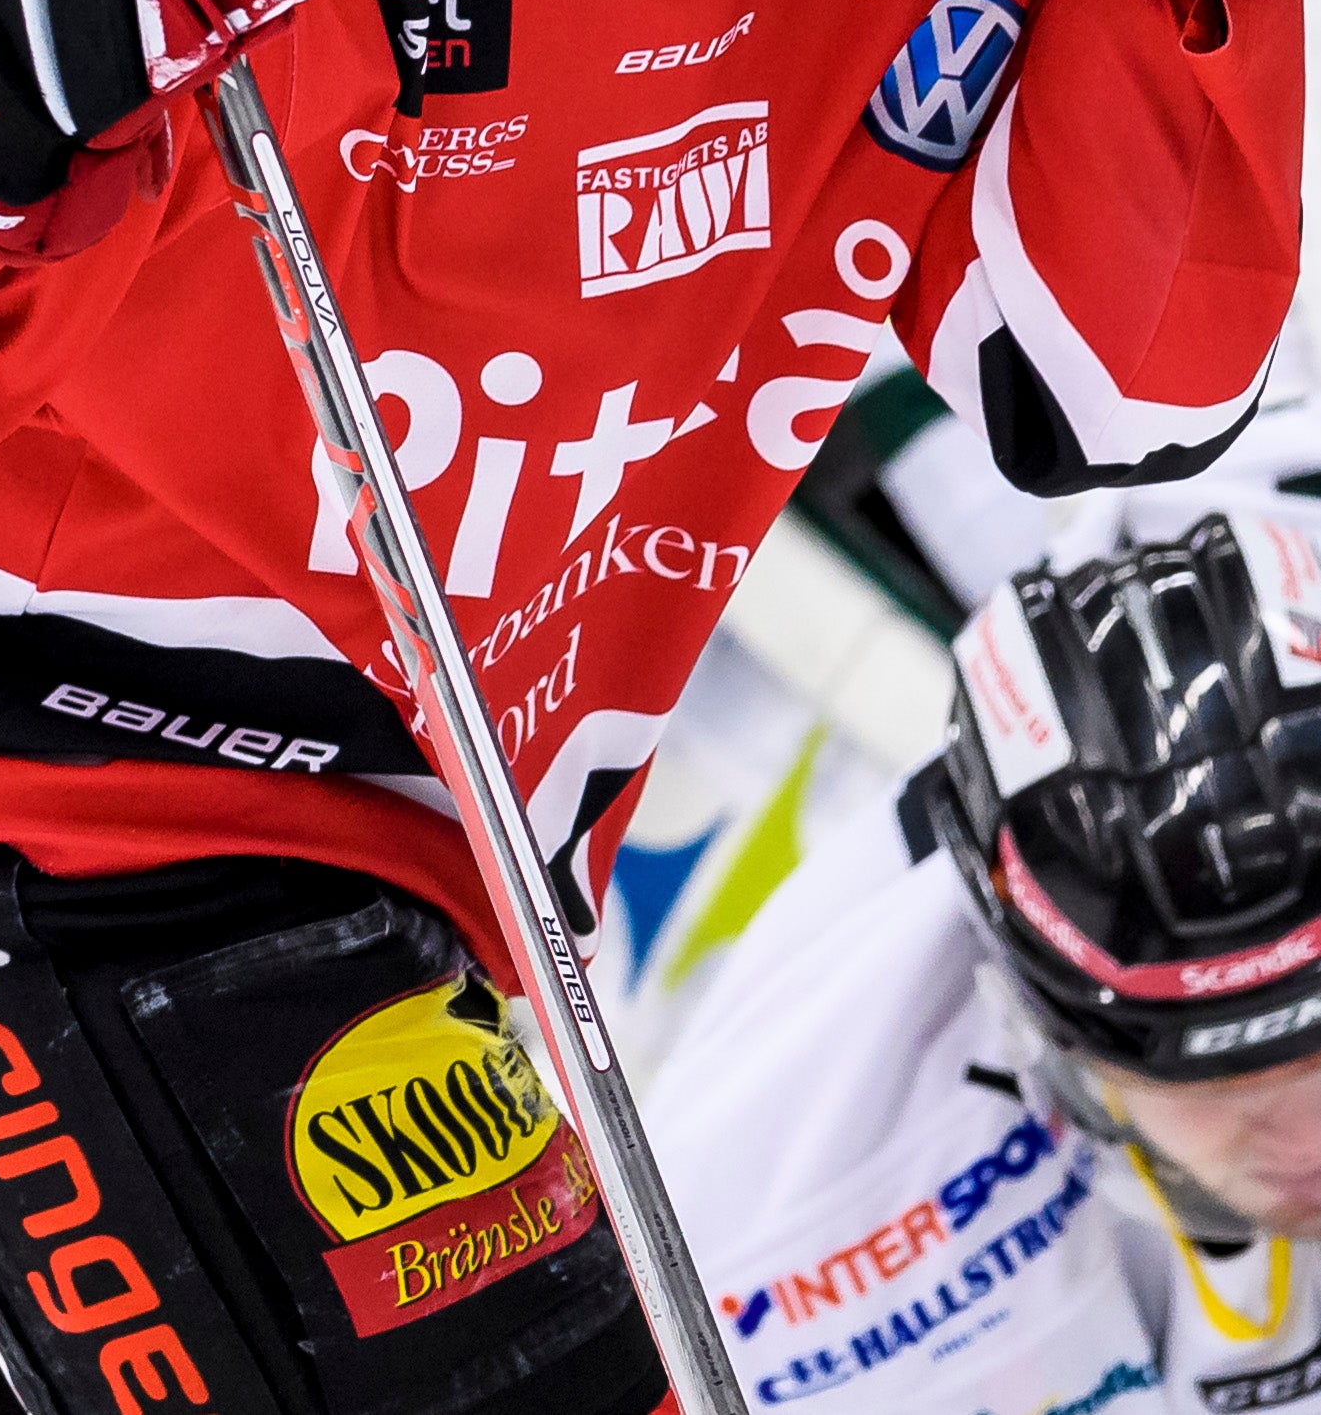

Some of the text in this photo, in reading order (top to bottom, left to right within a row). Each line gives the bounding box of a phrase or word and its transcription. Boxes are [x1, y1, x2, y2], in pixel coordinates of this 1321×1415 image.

[576, 121, 769, 192] FASTIGHETS AB
[385, 1187, 562, 1310] Bränsle
